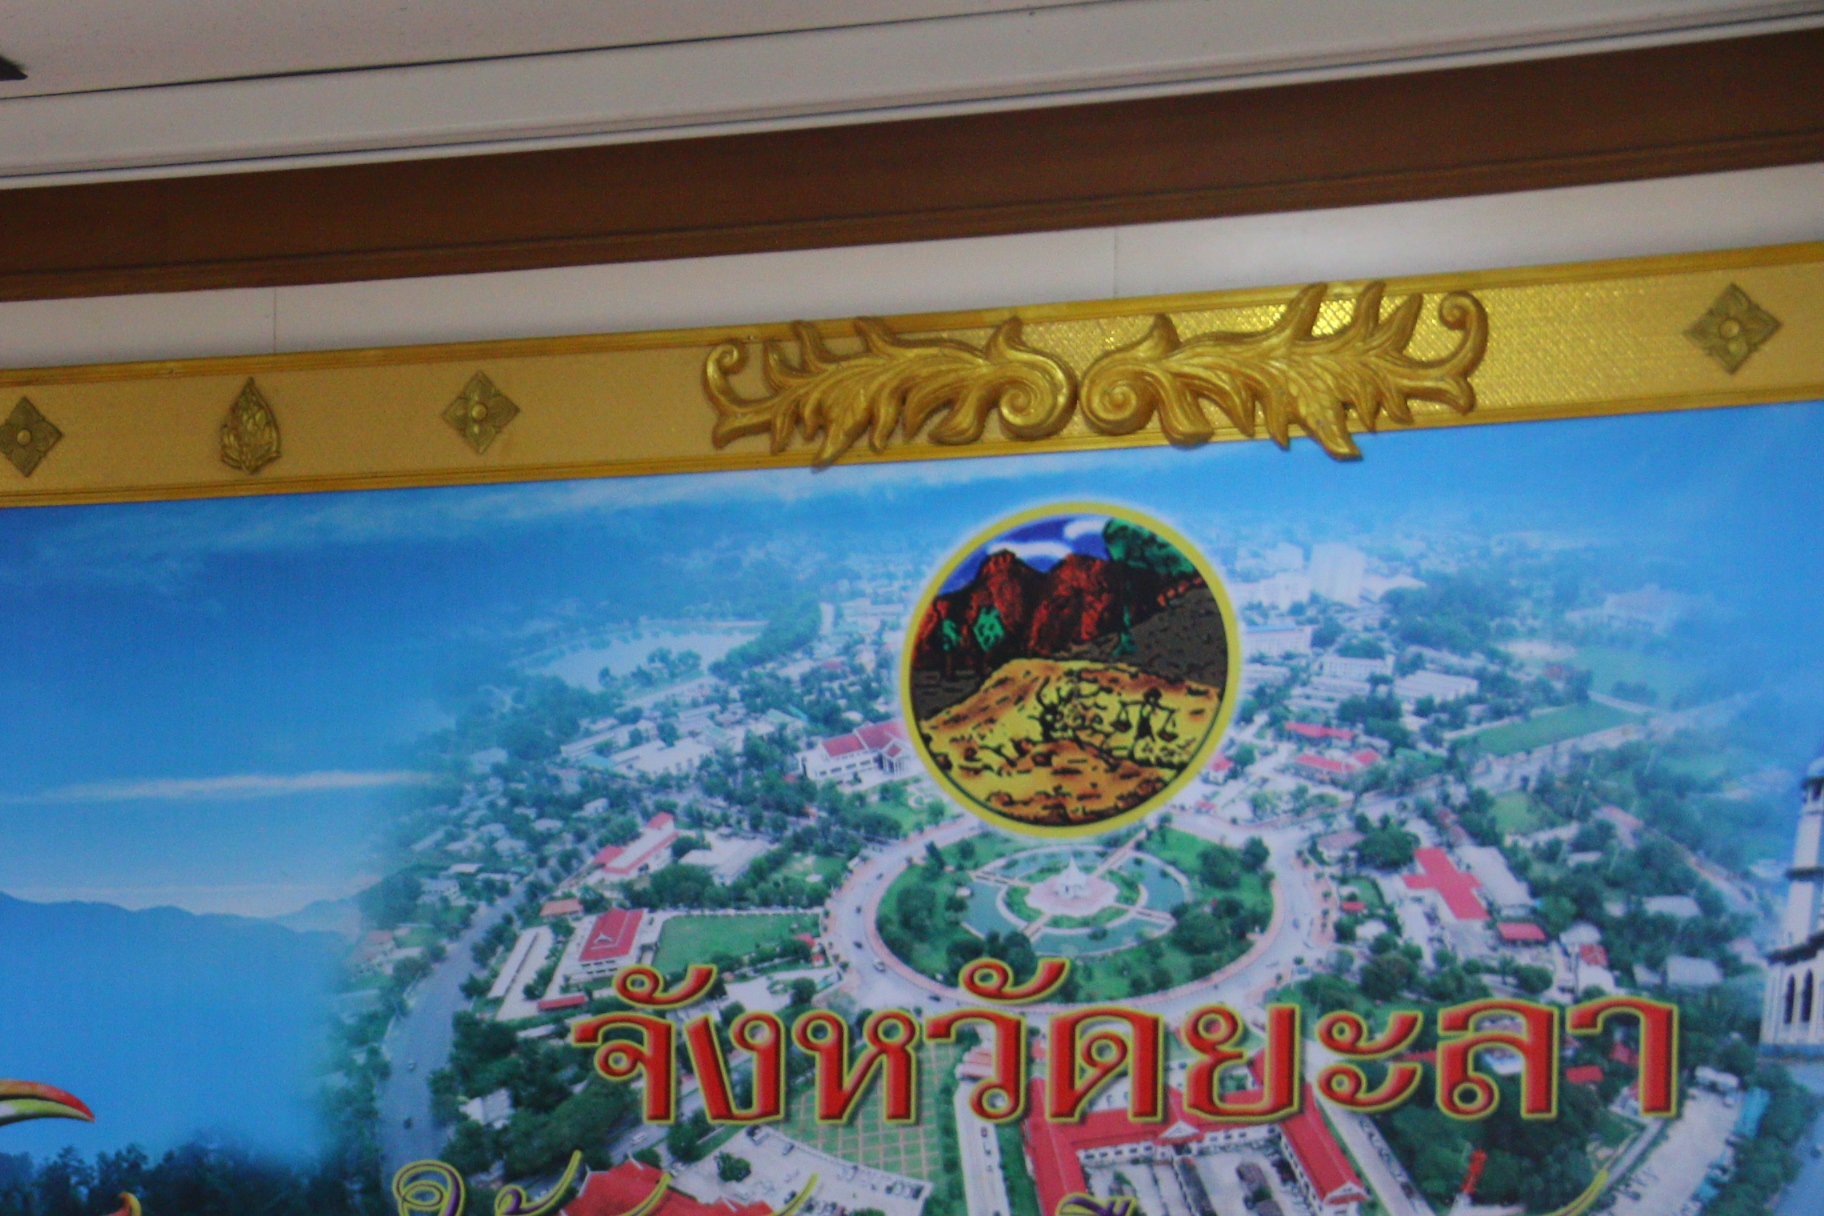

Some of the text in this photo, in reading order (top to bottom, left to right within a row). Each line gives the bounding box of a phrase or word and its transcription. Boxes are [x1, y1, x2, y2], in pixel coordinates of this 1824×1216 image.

[572, 956, 1681, 1126] จังหวัดยะลา
